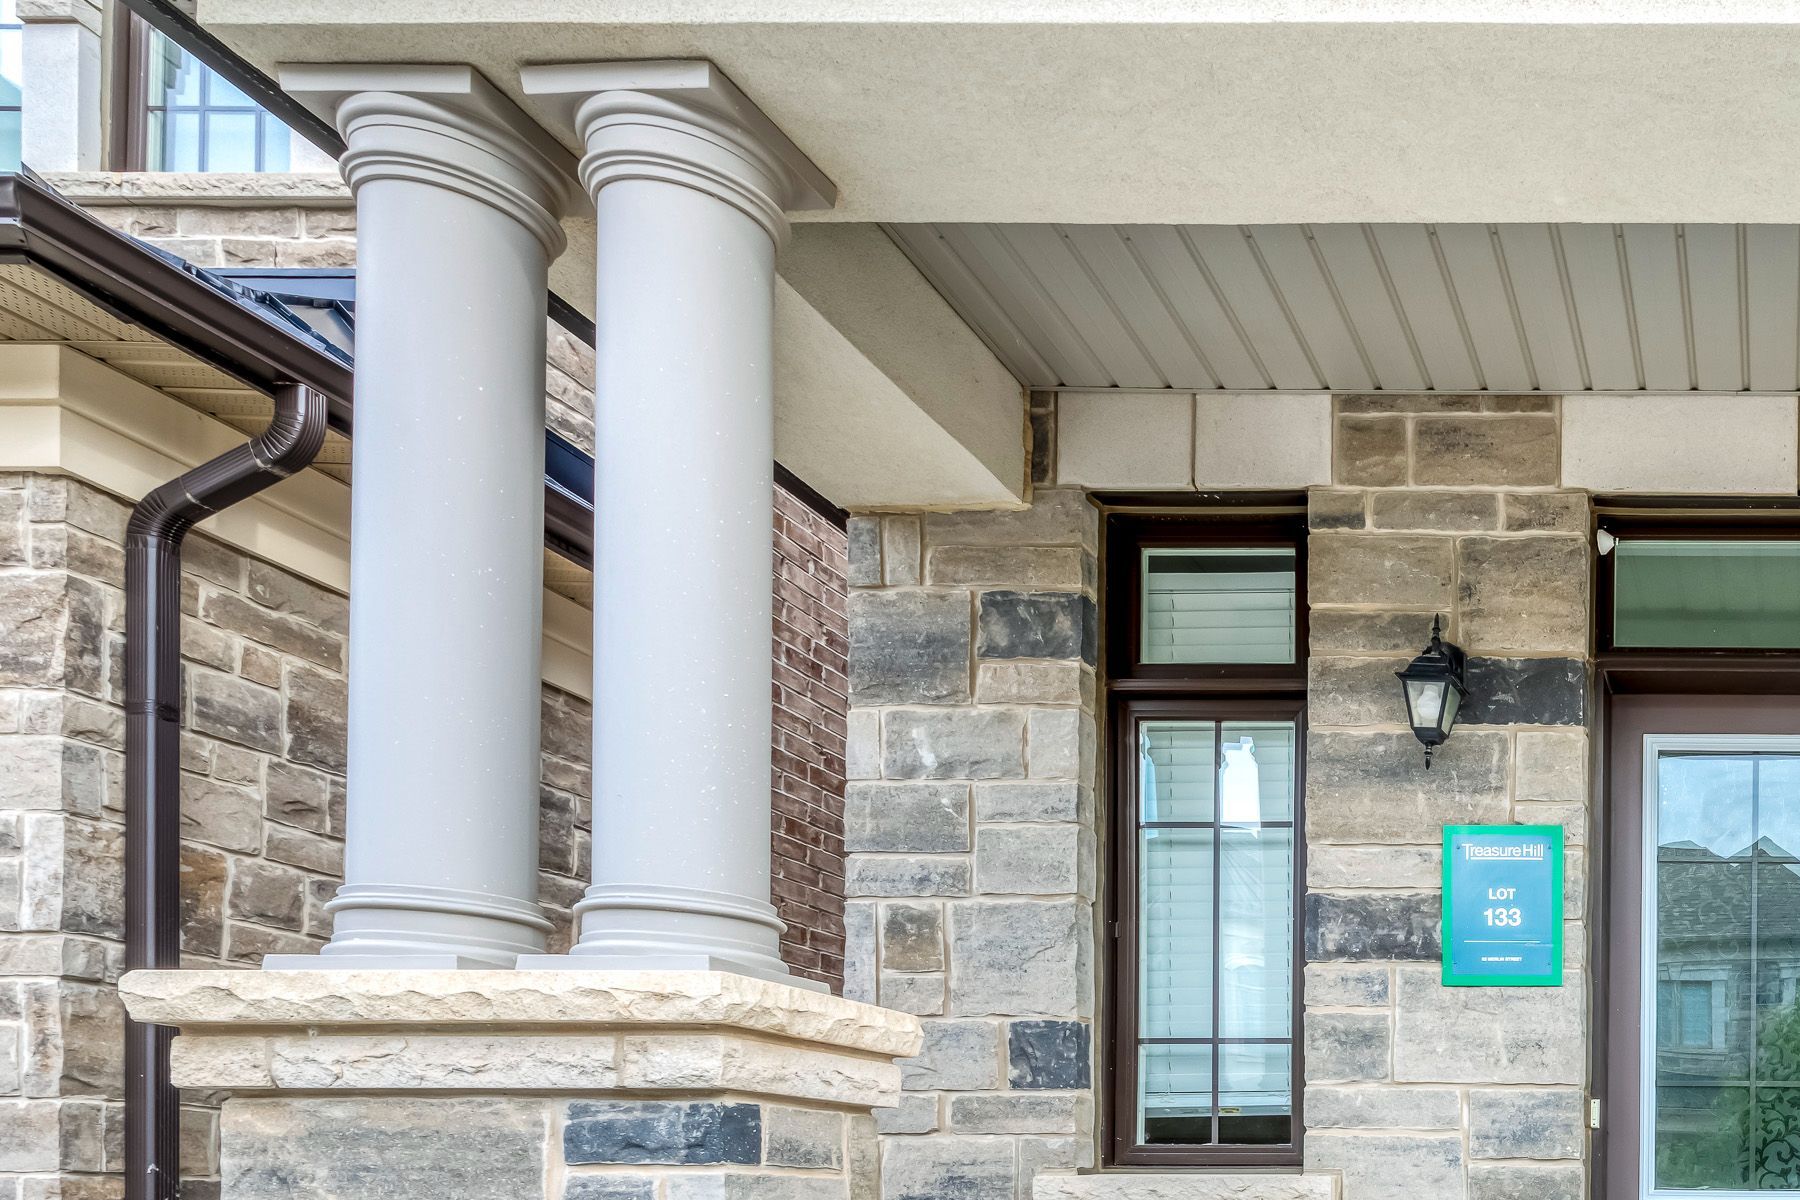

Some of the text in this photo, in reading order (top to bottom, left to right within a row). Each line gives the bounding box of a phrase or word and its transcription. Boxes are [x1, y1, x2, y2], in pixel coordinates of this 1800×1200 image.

[1461, 843, 1544, 861] Treasure Hill
[1488, 888, 1516, 900] LOT
[1483, 907, 1522, 927] 133
